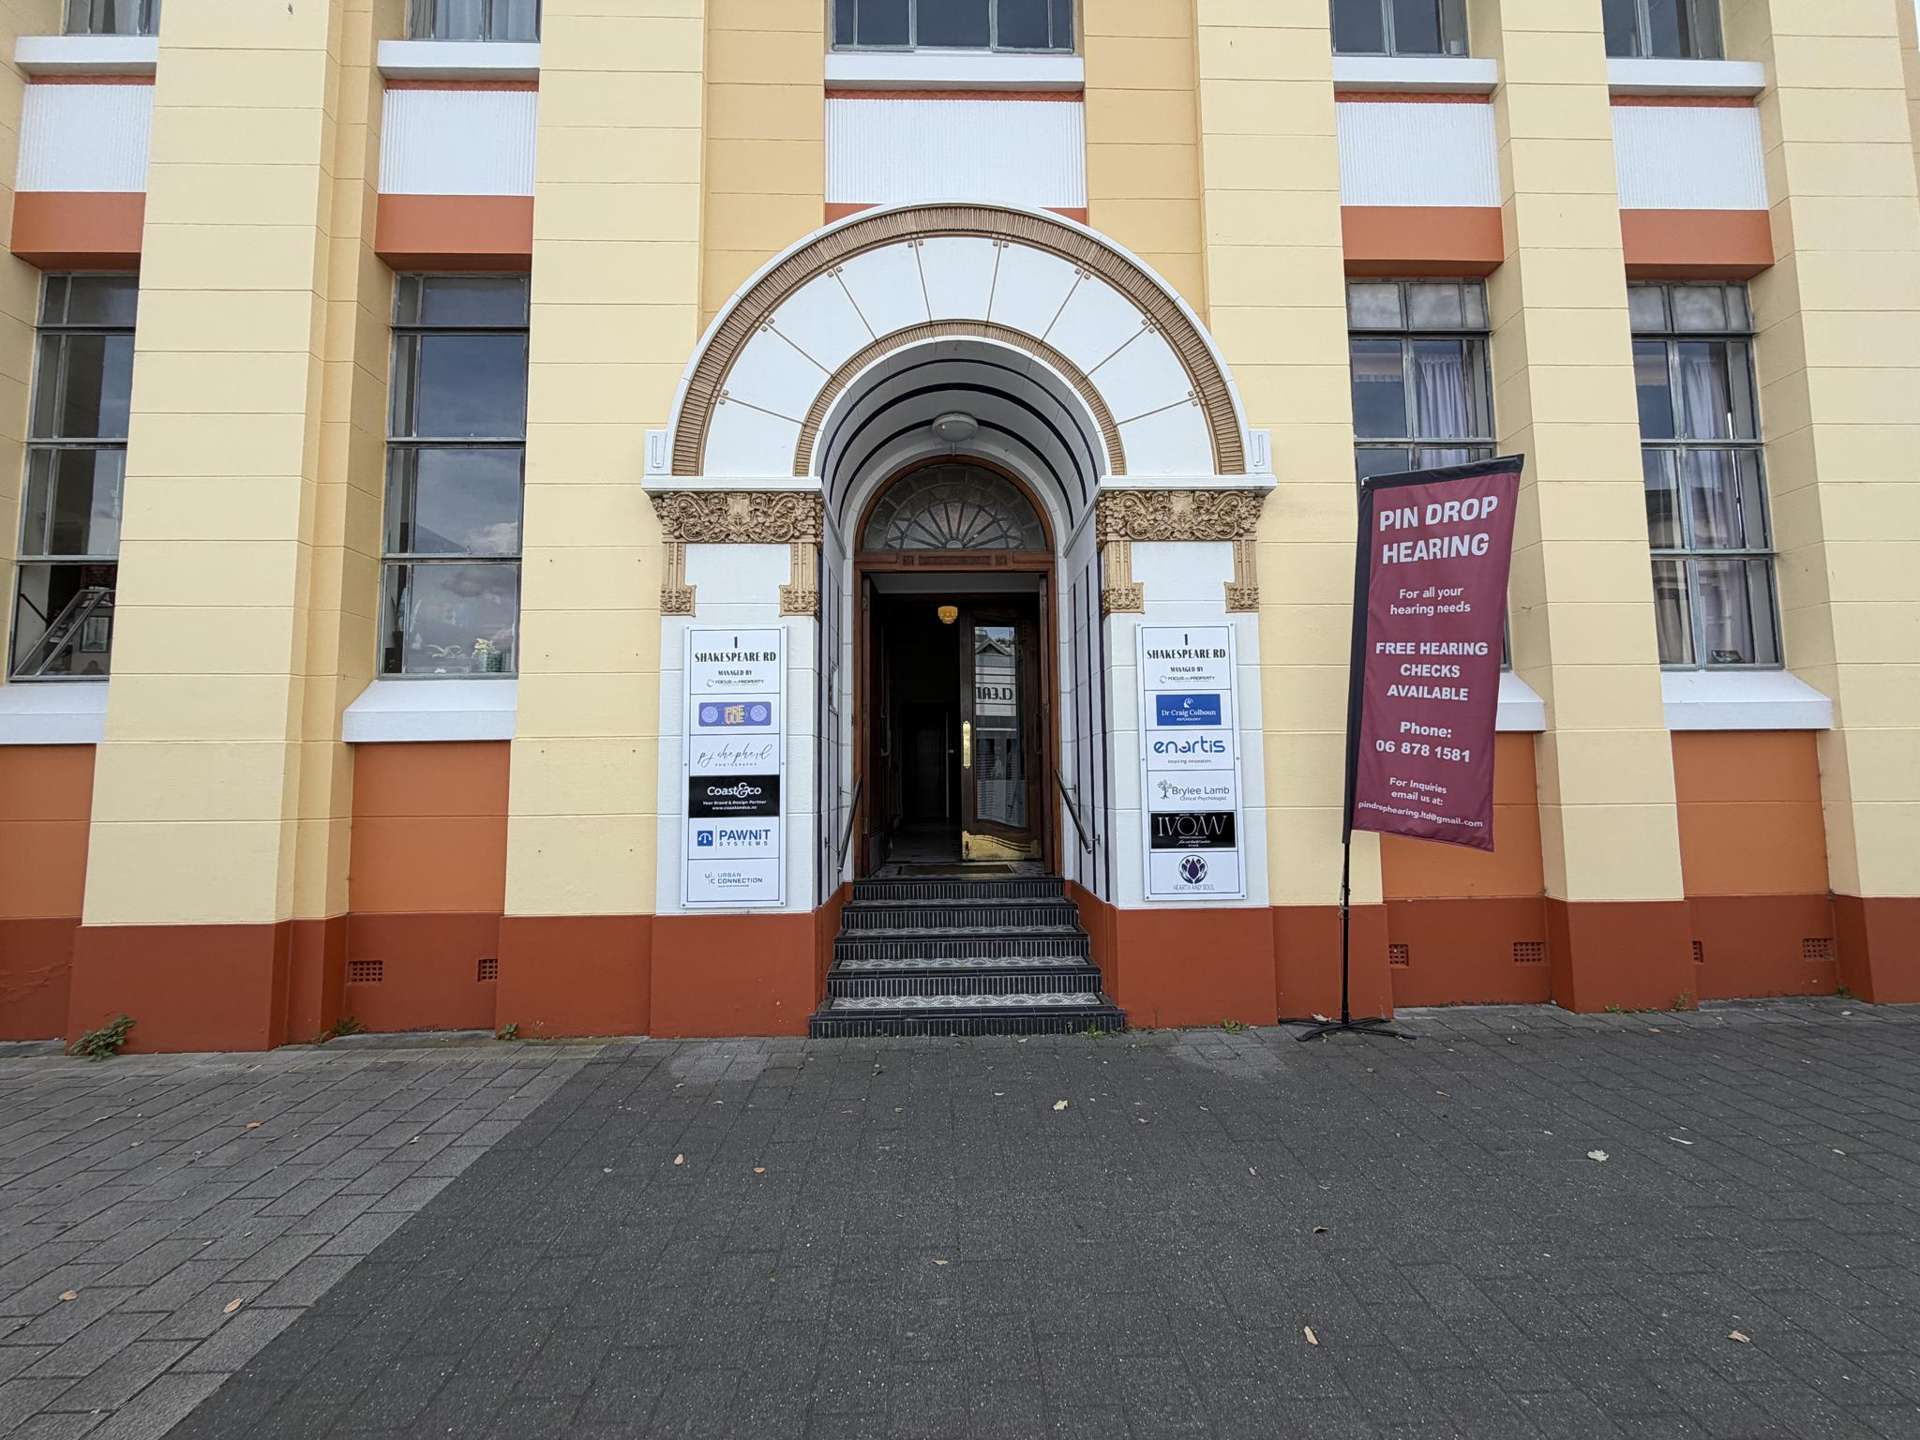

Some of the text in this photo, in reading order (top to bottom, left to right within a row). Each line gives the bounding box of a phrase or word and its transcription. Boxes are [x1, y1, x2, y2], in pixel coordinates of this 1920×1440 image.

[1379, 495, 1498, 531] PIN DROP
[1382, 533, 1490, 564] HEARING
[1399, 586, 1464, 600] For all your
[1390, 601, 1471, 616] hearing needs
[1146, 649, 1226, 660] SHAKESPEARE RD
[1375, 642, 1489, 655] FREE HEARING
[694, 651, 776, 663] SHAKESPEARE RD
[1400, 664, 1460, 678] CHECKS
[1387, 685, 1469, 701] AVAILABLE
[1171, 710, 1188, 718] Craig
[1400, 721, 1452, 738] Phone:
[1153, 735, 1226, 754] enartis
[1376, 740, 1470, 763] 06 878 1581
[1171, 786, 1230, 798] Brylee Lamb
[1390, 777, 1447, 794] For Inquiries
[1391, 791, 1443, 806] email us at:
